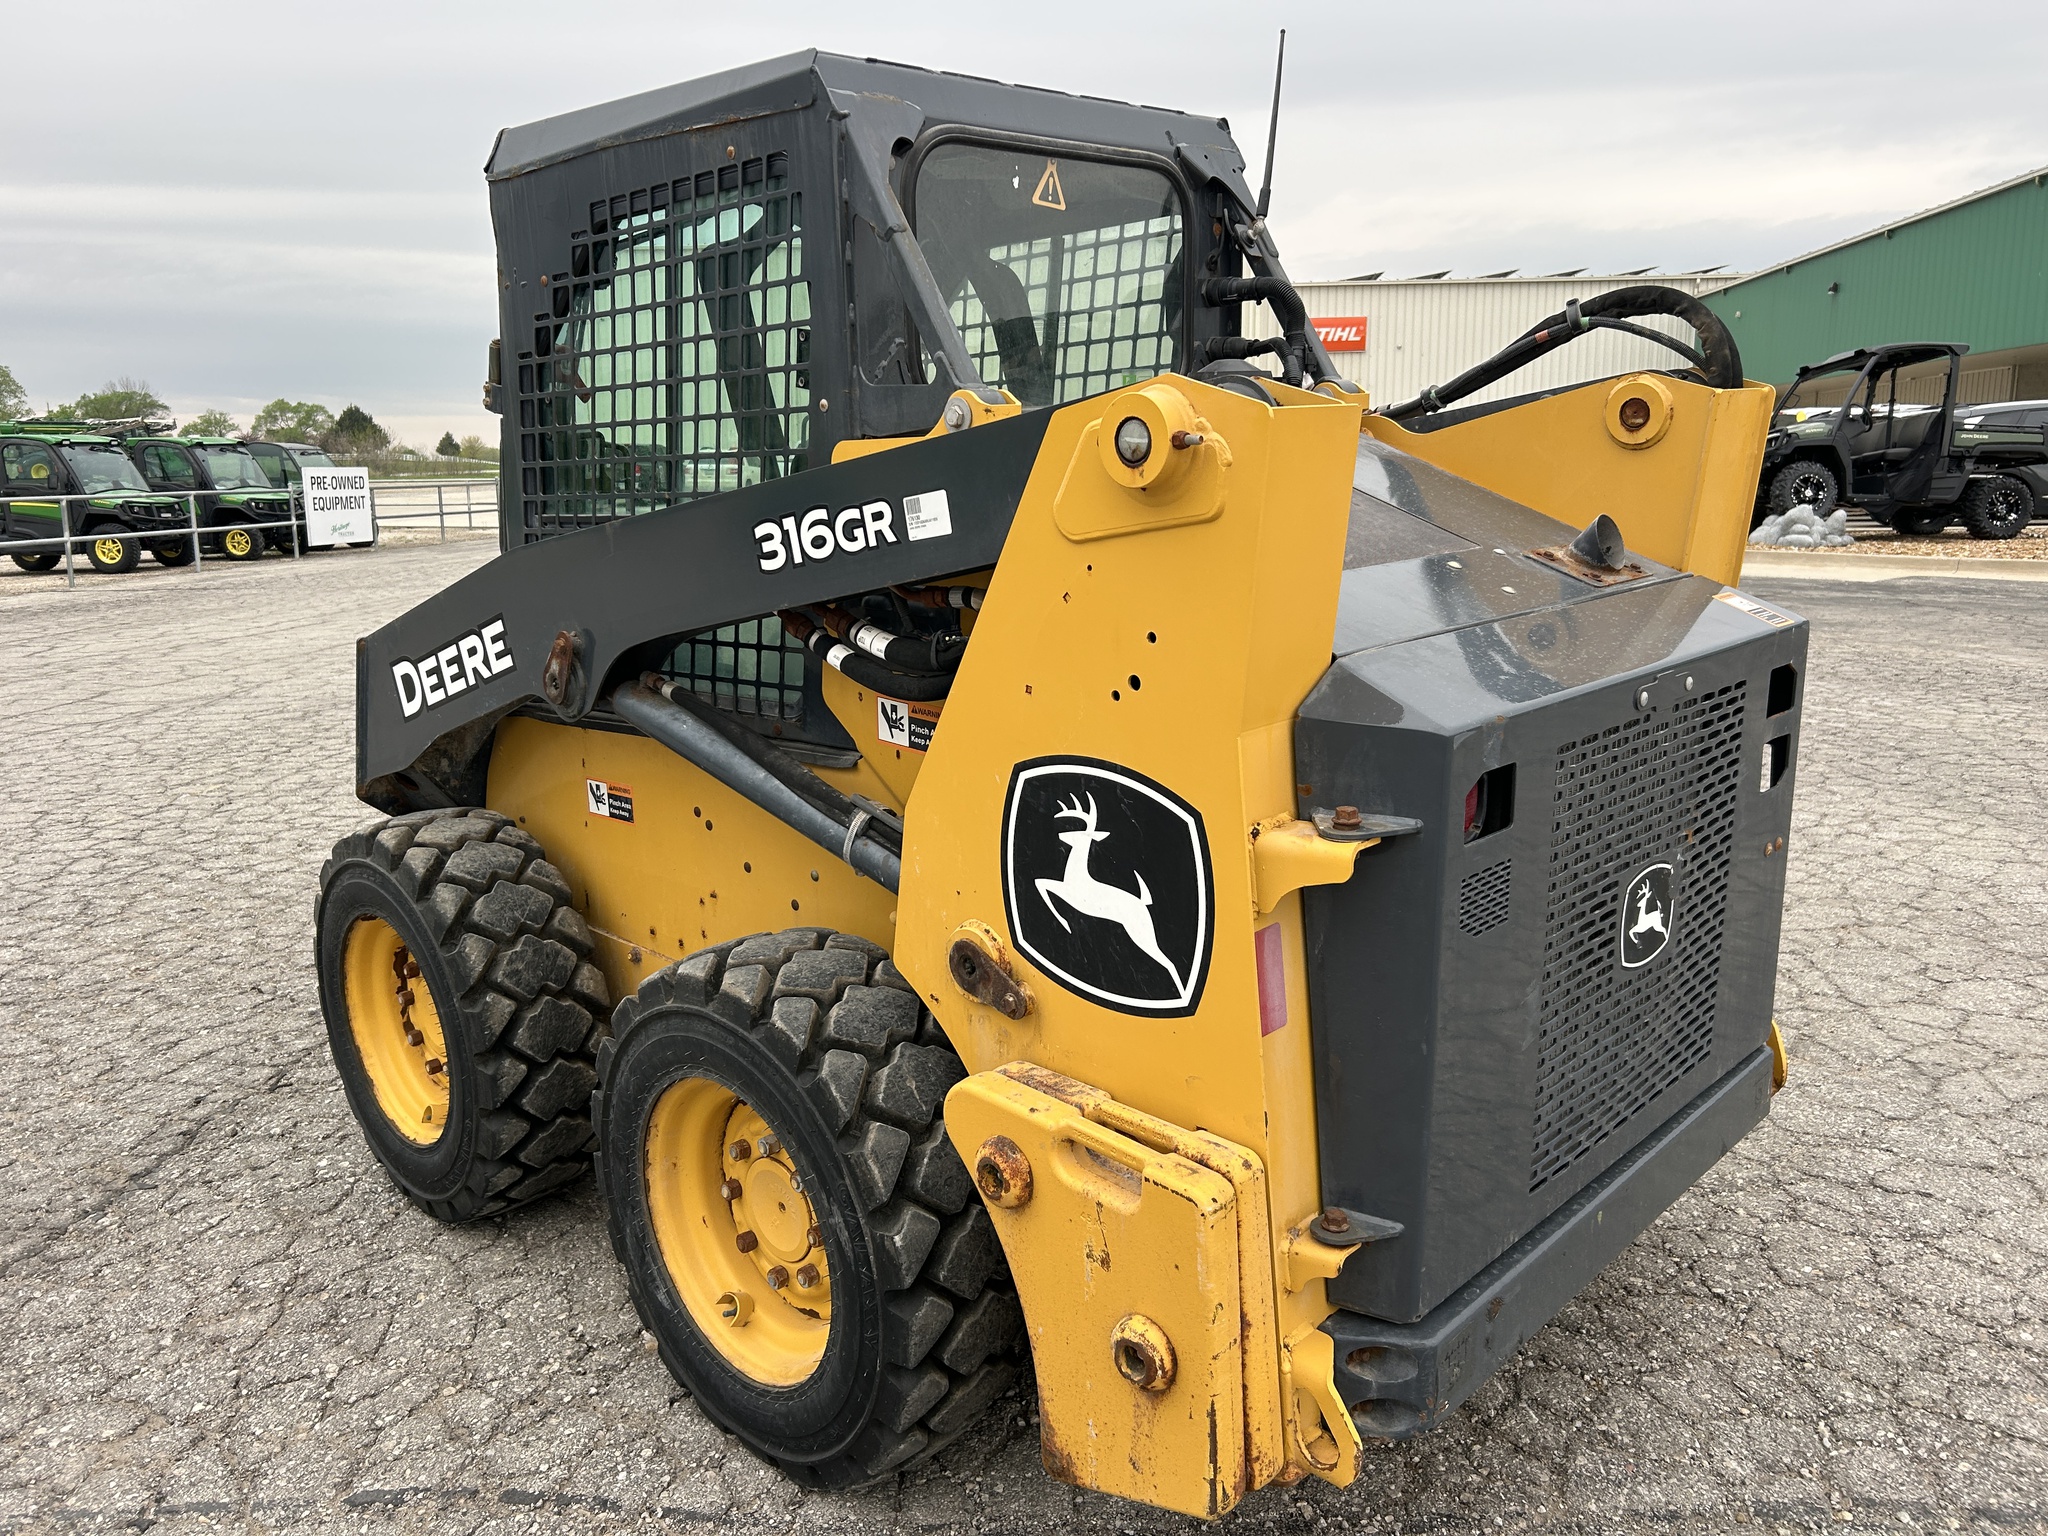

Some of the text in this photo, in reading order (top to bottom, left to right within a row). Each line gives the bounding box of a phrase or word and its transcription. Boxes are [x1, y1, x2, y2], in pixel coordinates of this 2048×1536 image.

[310, 475, 365, 490] PRE-OWNED
[313, 495, 366, 512] EQUIPMENT
[753, 500, 898, 572] 316GR
[392, 619, 514, 718] DEERE
[917, 707, 941, 719] WARNIN
[910, 723, 930, 736] Pinch
[910, 735, 926, 746] Keep
[609, 798, 621, 807] Pinch
